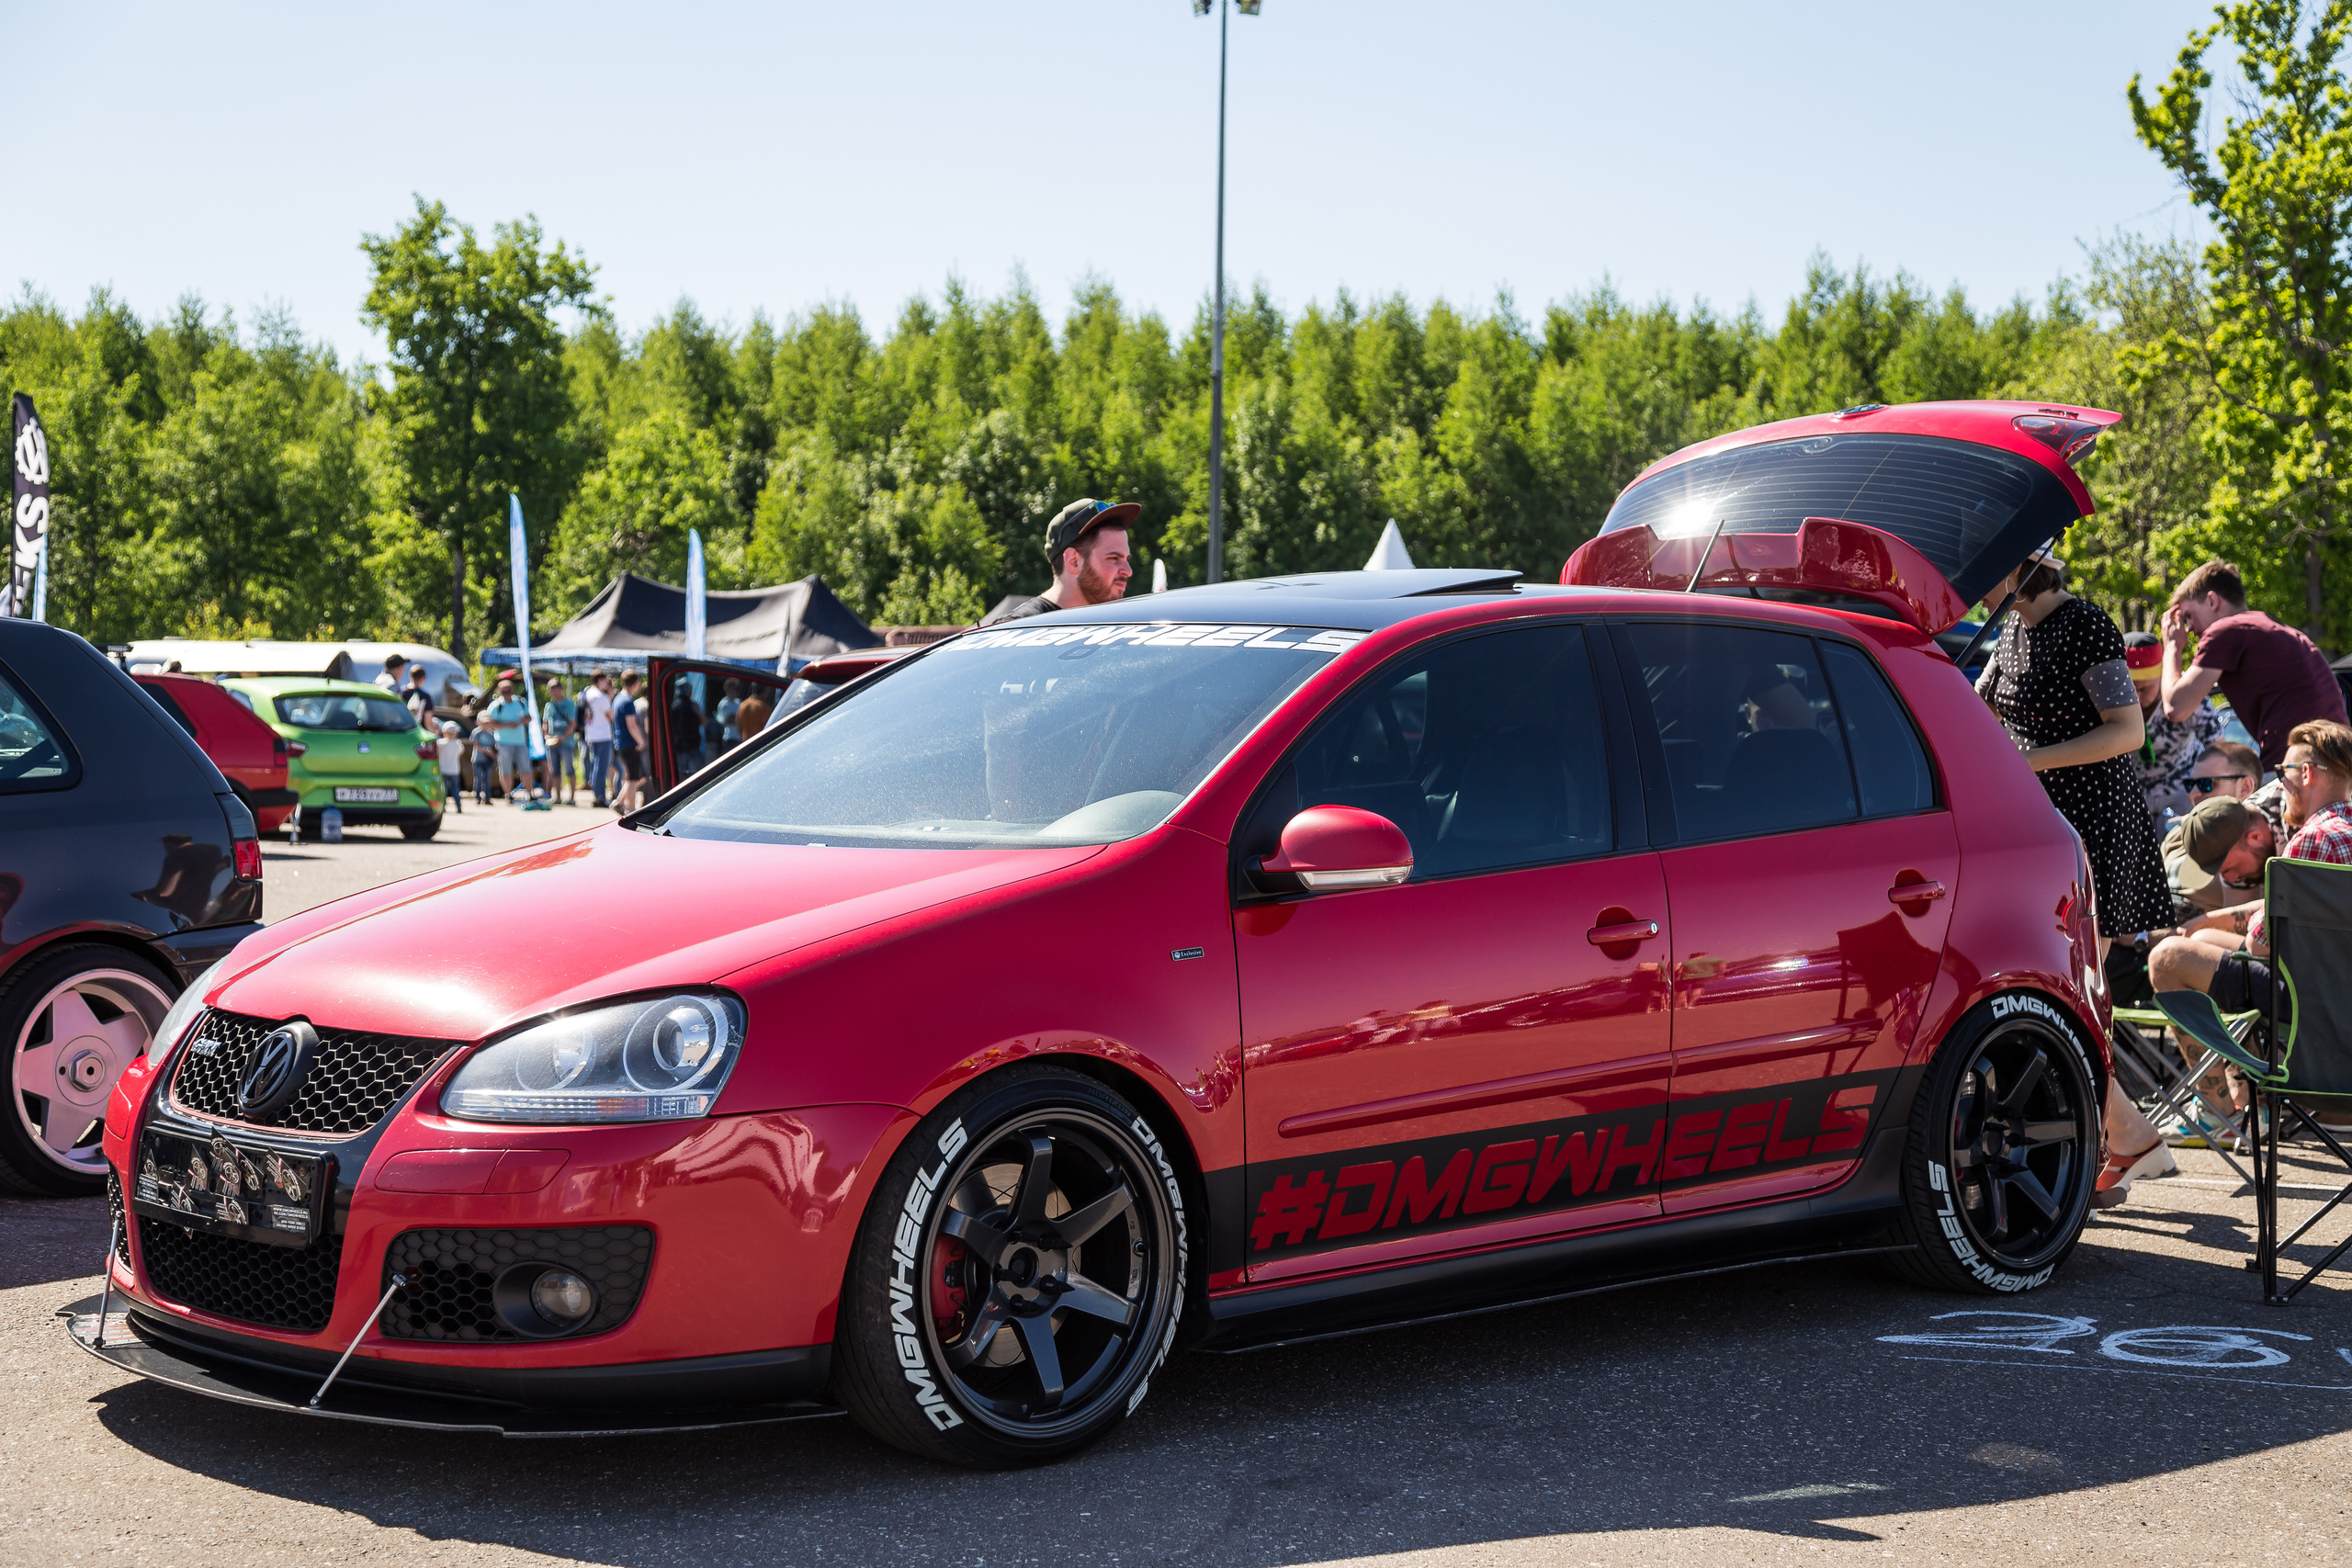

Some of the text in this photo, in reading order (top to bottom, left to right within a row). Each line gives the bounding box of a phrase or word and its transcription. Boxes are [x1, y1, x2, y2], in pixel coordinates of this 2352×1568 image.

[191, 1038, 221, 1056] GTI
[1087, 1087, 1133, 1118] HORIZON
[1250, 1085, 1877, 1251] #DMGWHEELS
[1928, 1160, 2055, 1292] DMGWHEELS
[889, 1117, 968, 1431] DMGWHEELS
[1125, 1115, 1188, 1417] DMGWHEELS
